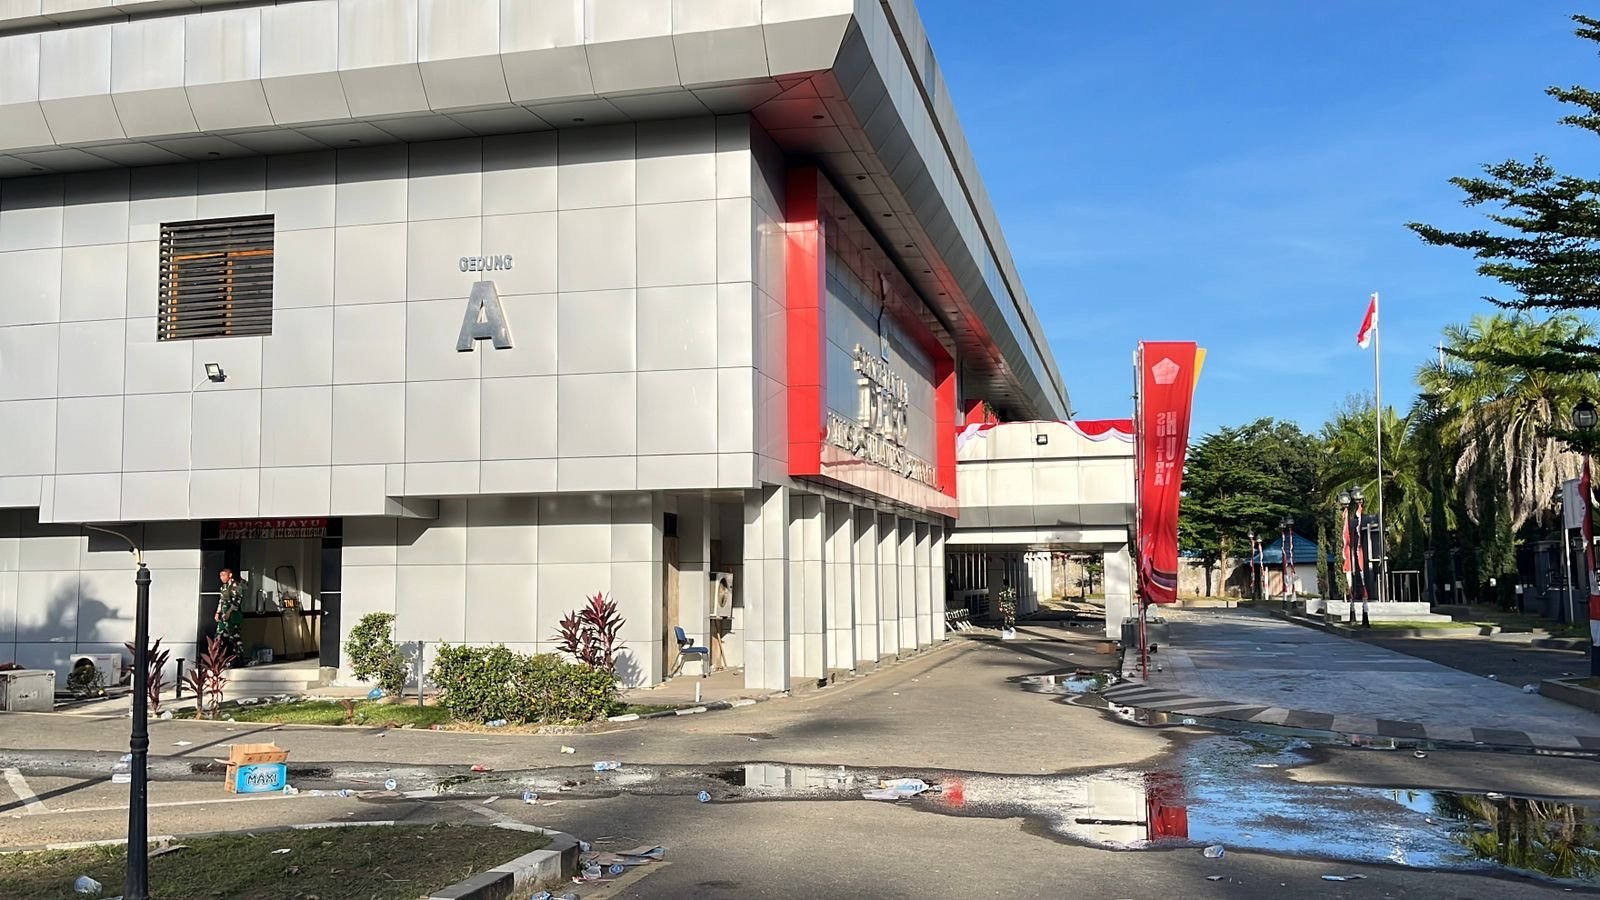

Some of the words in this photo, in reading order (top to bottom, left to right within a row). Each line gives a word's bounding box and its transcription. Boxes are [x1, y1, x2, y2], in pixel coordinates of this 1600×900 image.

[459, 255, 513, 272] GEDUNG
[456, 281, 512, 352] A
[247, 773, 277, 784] MAXI
